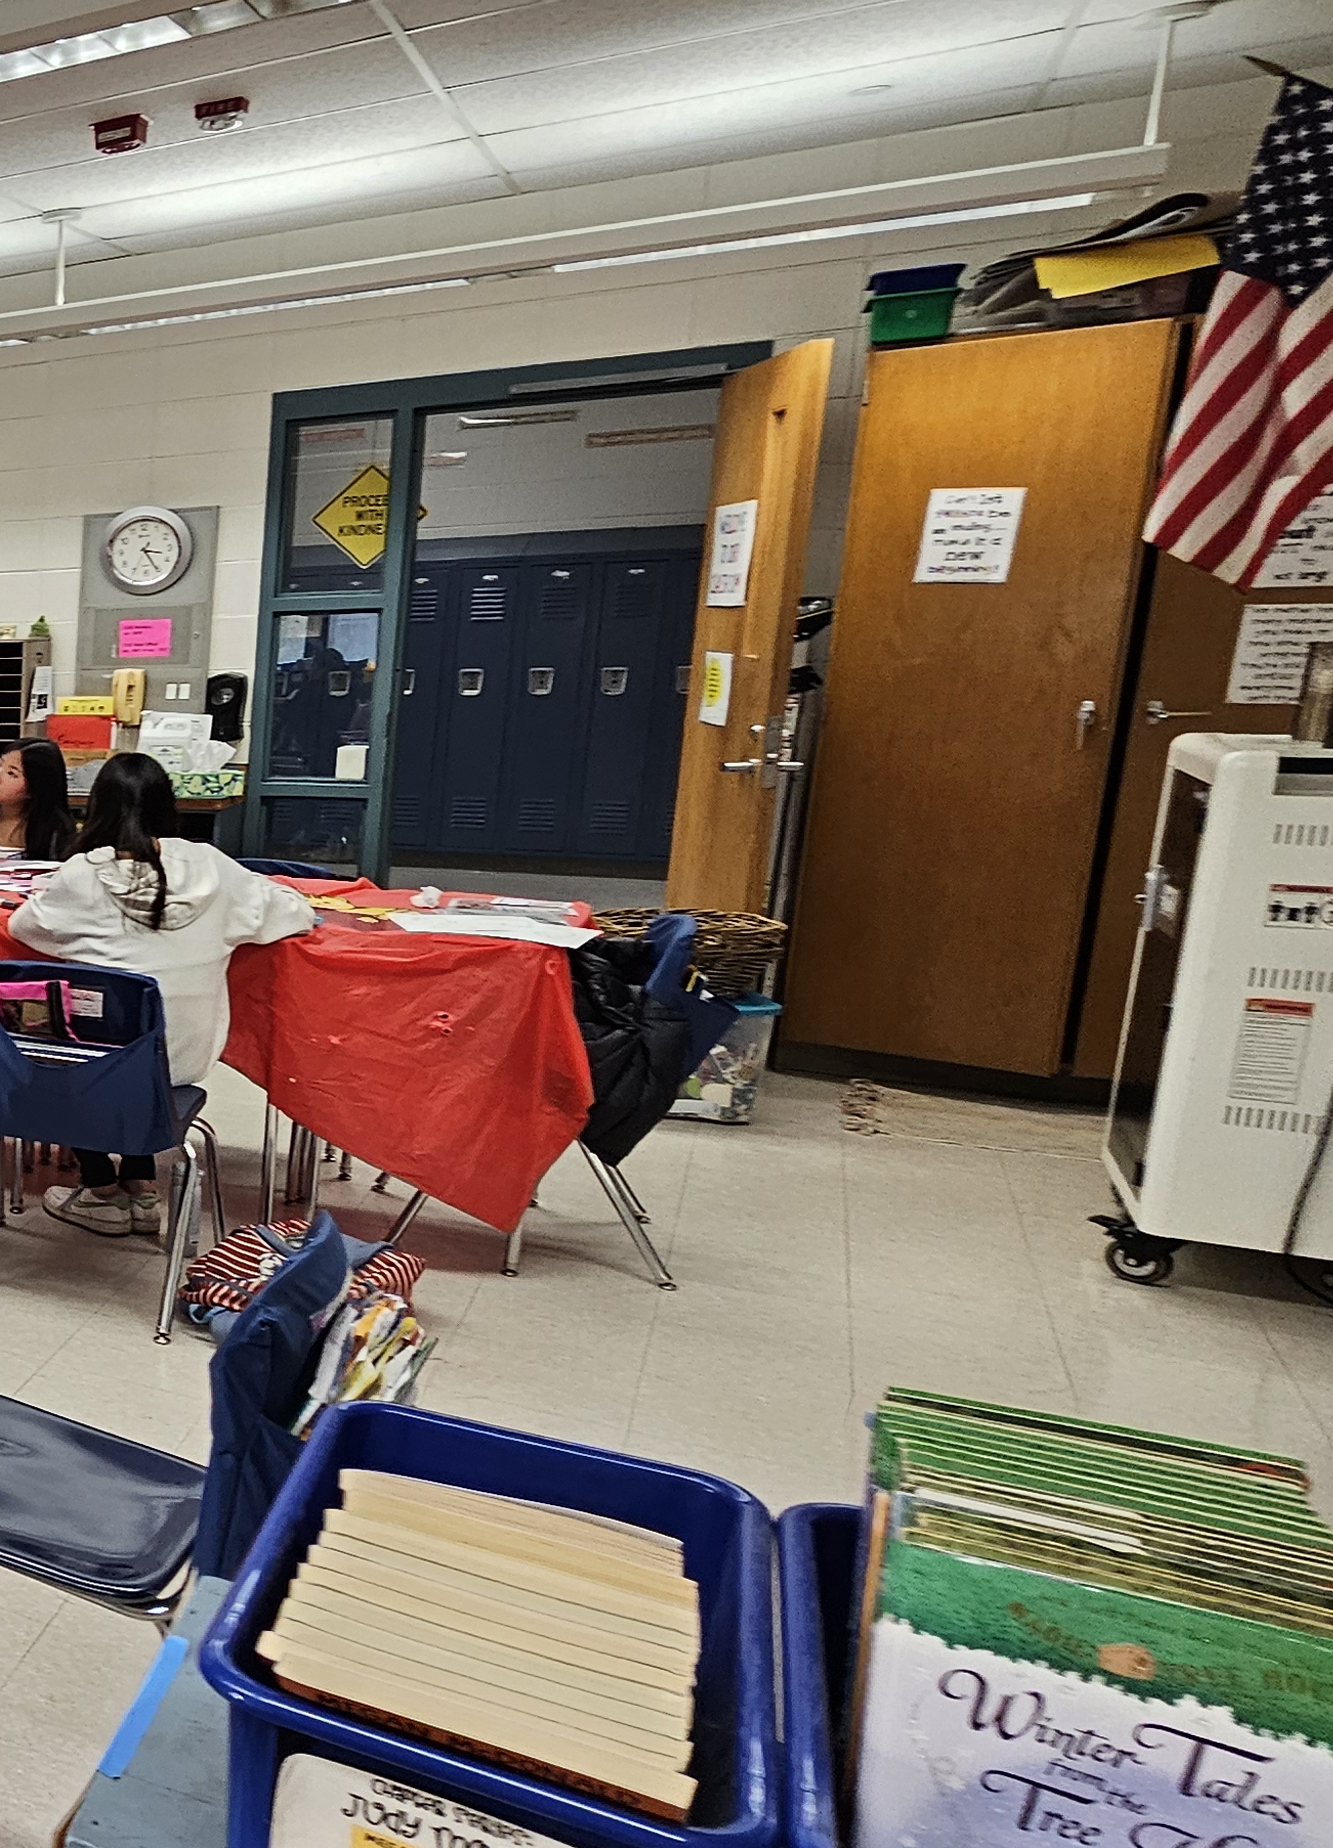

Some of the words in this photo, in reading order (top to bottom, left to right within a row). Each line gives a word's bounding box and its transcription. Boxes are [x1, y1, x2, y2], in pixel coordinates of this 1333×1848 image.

[342, 494, 389, 508] PROCEE
[355, 509, 384, 521] WITH
[337, 523, 384, 536] KINDNE
[938, 1668, 1147, 1769] Winter
[1133, 1722, 1306, 1825] Tales
[979, 1769, 1104, 1847] Tree
